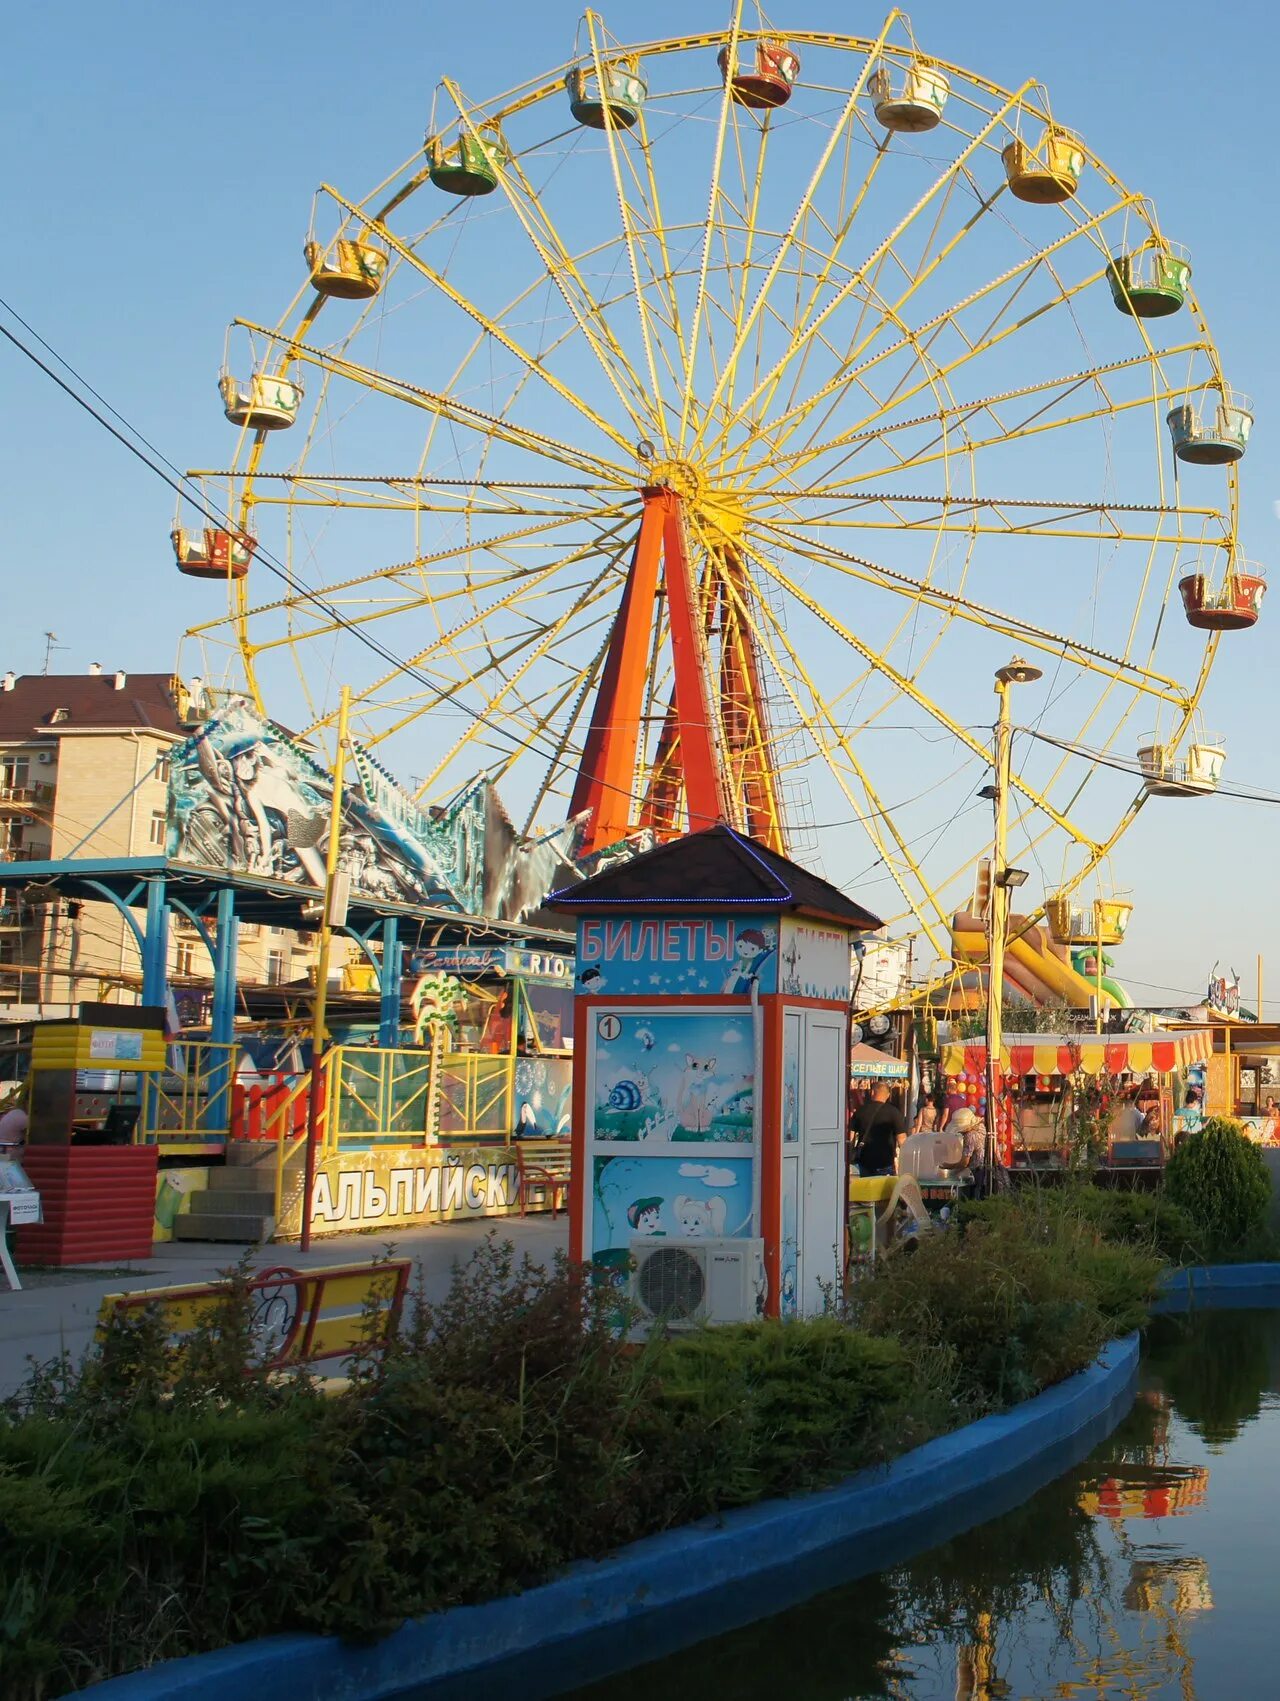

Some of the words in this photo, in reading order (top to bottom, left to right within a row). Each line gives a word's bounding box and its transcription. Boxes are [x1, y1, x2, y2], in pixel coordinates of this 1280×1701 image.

[581, 919, 735, 962] БИЛЕТЫ
[420, 950, 500, 968] Carnival
[530, 954, 565, 977] RIO
[603, 1017, 613, 1037] 1
